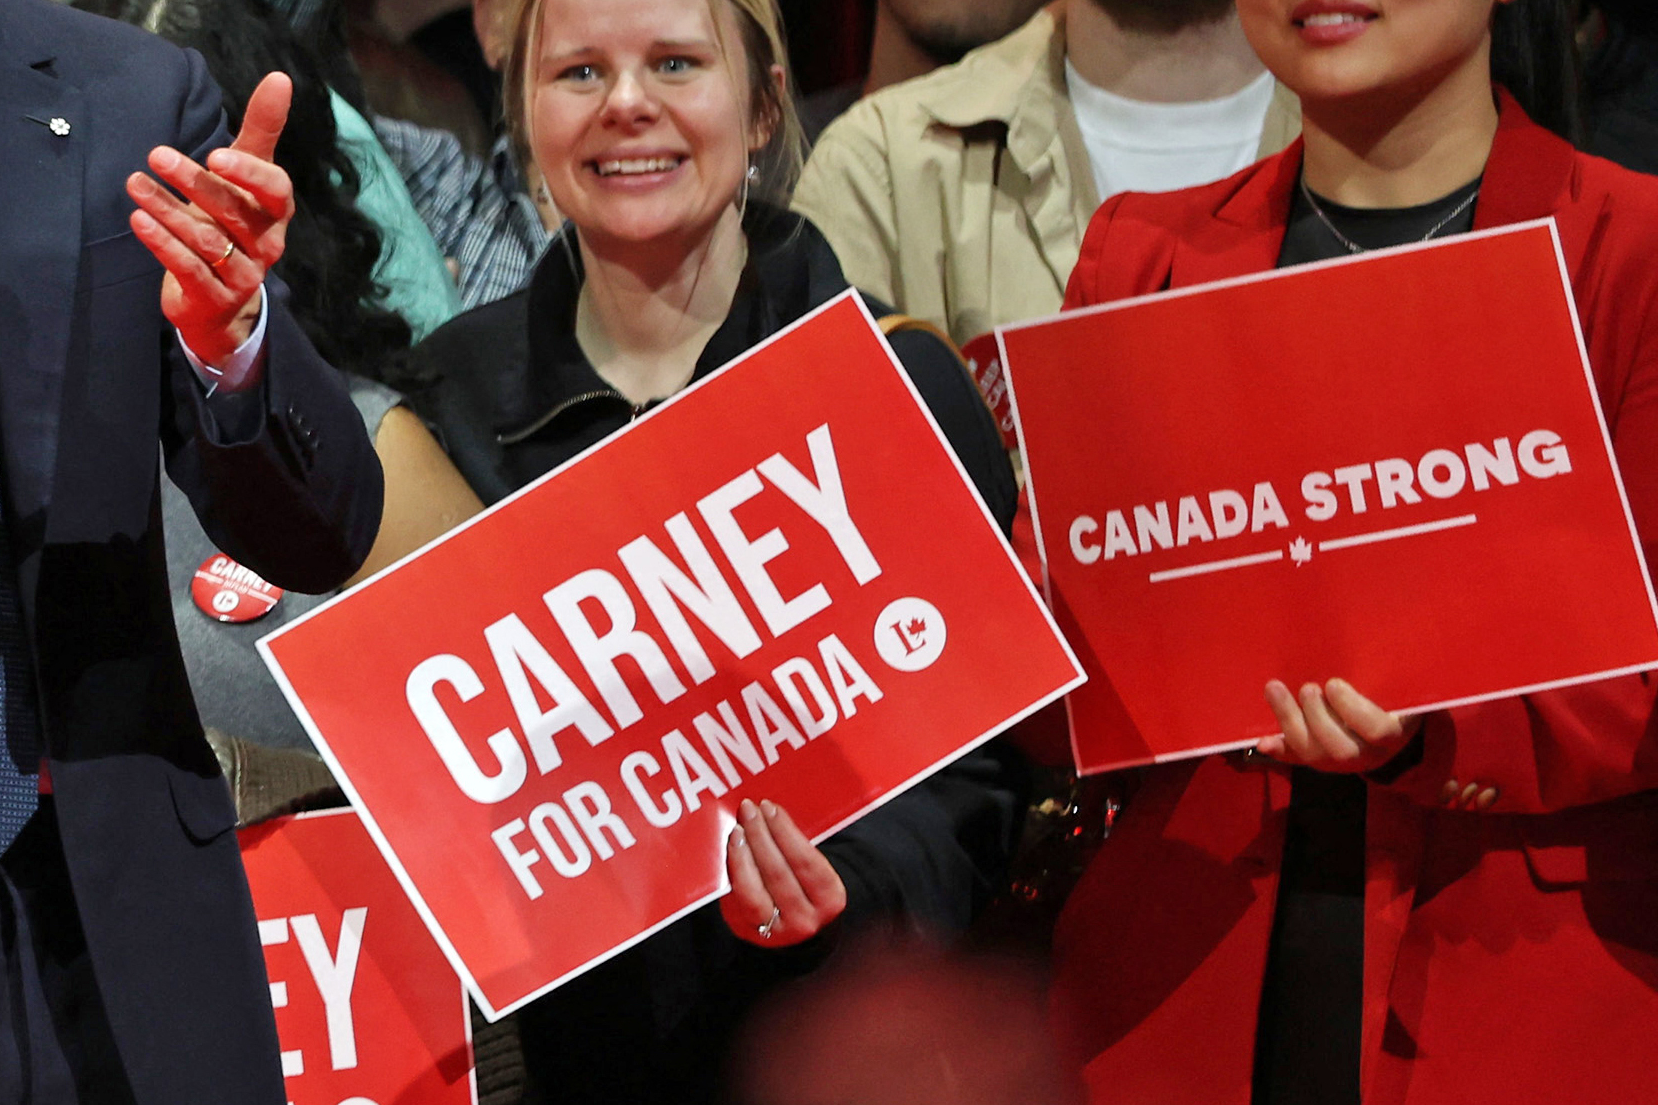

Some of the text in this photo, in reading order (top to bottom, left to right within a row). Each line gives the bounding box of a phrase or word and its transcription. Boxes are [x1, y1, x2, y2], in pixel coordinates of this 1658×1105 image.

[405, 422, 883, 805] CARNEY
[1069, 429, 1573, 565] CANADA STRONG
[490, 633, 884, 901] FOR CANADA
